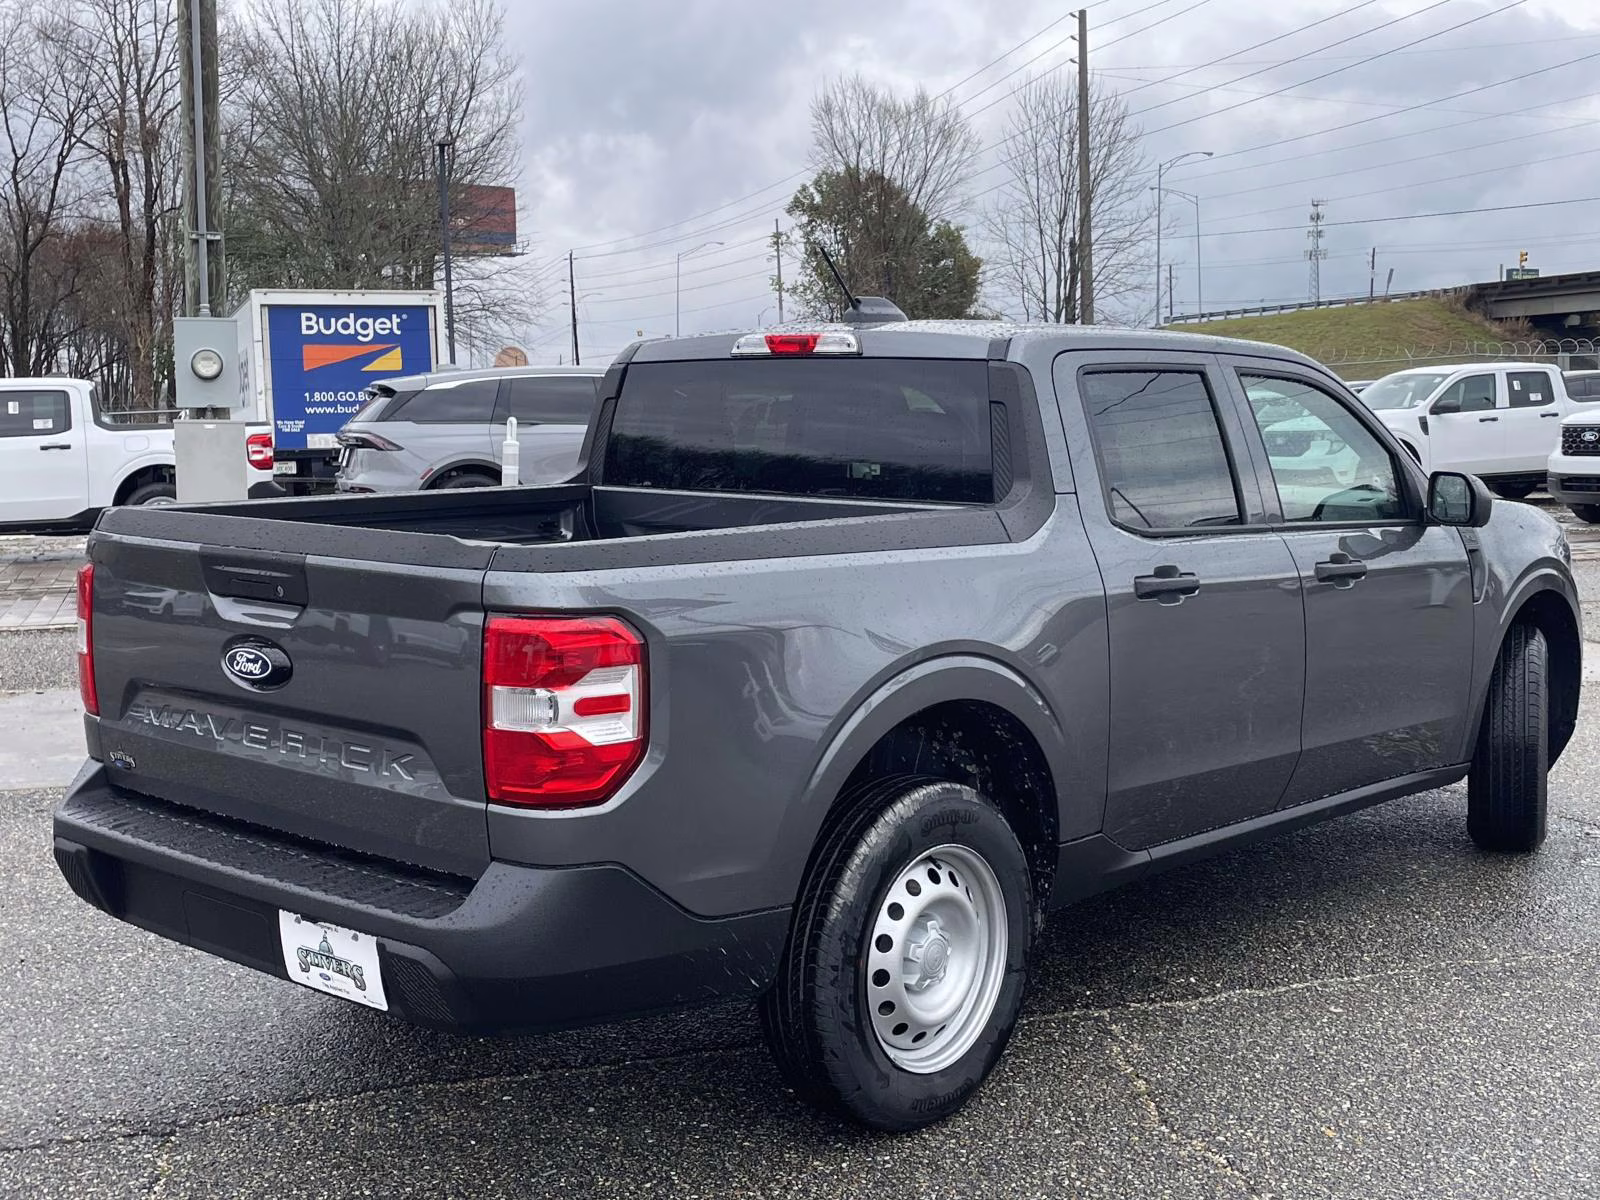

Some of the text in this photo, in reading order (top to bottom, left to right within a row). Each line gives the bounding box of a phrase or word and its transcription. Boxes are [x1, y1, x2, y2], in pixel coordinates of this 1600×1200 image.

[300, 312, 402, 342] Budget
[305, 404, 360, 414] www.bud
[233, 651, 262, 675] Ford
[144, 703, 415, 781] MAVERICK
[297, 947, 367, 991] STIVERS
